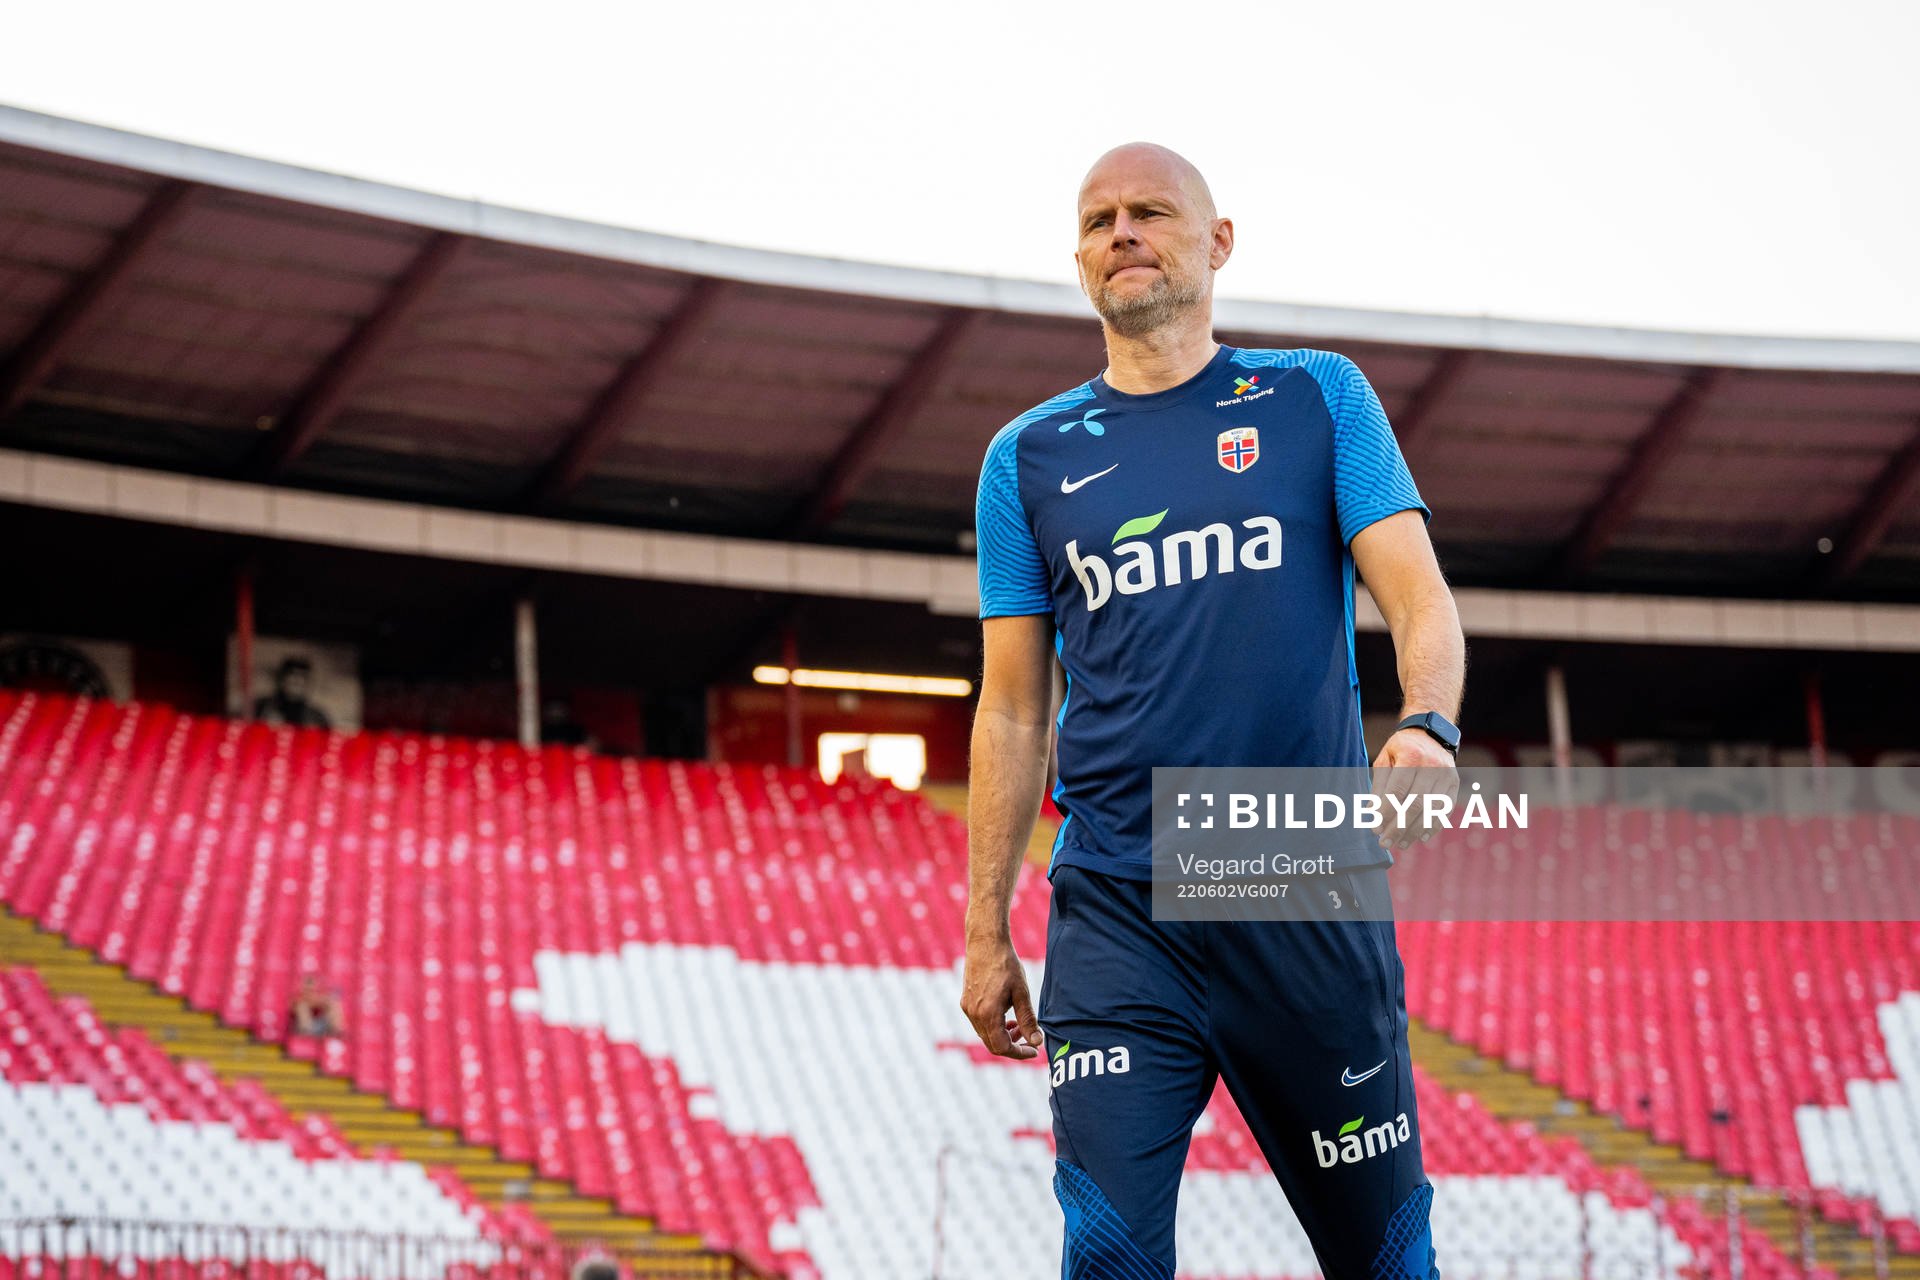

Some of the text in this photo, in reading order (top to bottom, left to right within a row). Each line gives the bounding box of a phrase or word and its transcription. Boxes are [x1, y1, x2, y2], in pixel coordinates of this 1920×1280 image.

[1216, 387, 1274, 408] Norsk Tipping
[1065, 515, 1282, 612] bama
[1049, 1046, 1130, 1096] ama
[1311, 1112, 1411, 1168] bama
